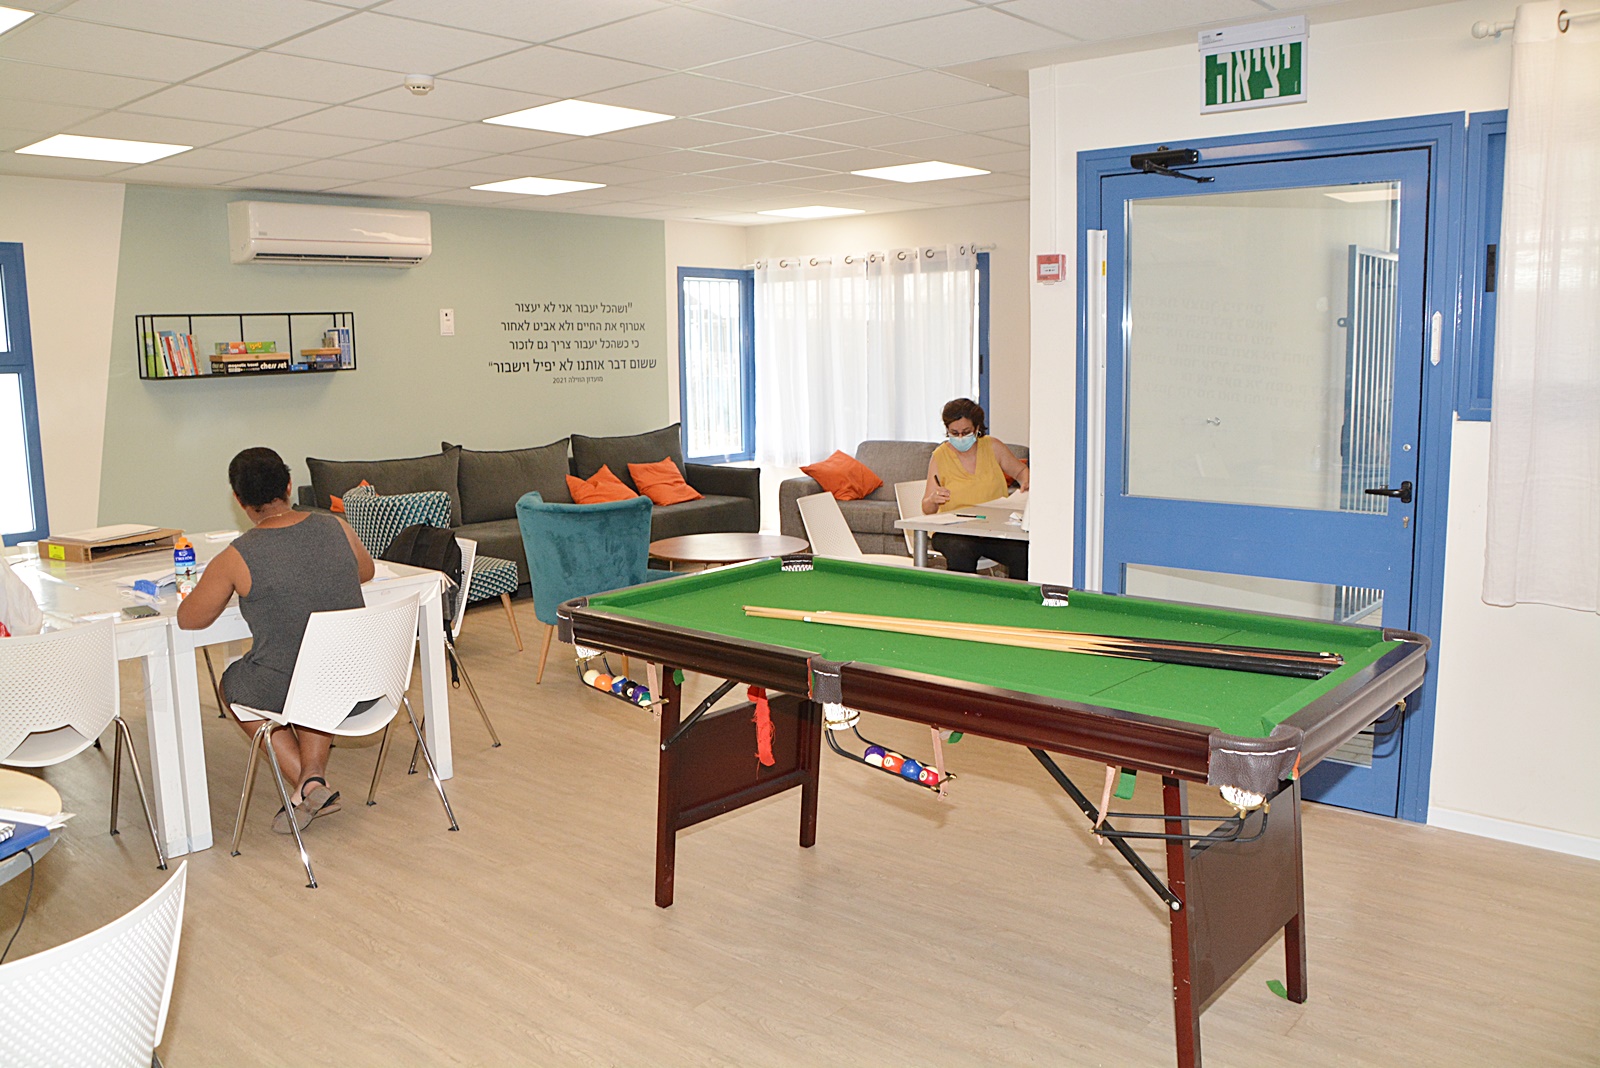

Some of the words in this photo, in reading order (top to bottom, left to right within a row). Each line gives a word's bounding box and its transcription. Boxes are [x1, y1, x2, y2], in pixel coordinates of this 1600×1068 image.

[1216, 43, 1291, 104] יציאה
[514, 303, 541, 313] יעצור
[543, 301, 556, 313] לא
[558, 303, 573, 313] אני
[575, 304, 598, 314] יעבור
[500, 319, 531, 331] לאחור
[533, 322, 556, 331] אביט
[558, 319, 574, 331] ולא
[576, 322, 602, 331] החיים
[604, 322, 617, 331] את
[619, 322, 646, 333] אטרוף
[508, 338, 534, 350] לזכור
[536, 340, 549, 350] גם
[550, 340, 571, 352] צריך
[574, 340, 598, 350] יעבור
[599, 337, 629, 349] כשהכל
[631, 339, 640, 349] כי
[260, 362, 277, 370] chess
[277, 361, 287, 369] set
[532, 358, 556, 372] יפיל
[558, 357, 574, 371] לא
[576, 360, 605, 371] אותנו
[607, 359, 627, 370] דבר
[629, 359, 657, 369] ששום
[586, 376, 604, 384] מועדון
